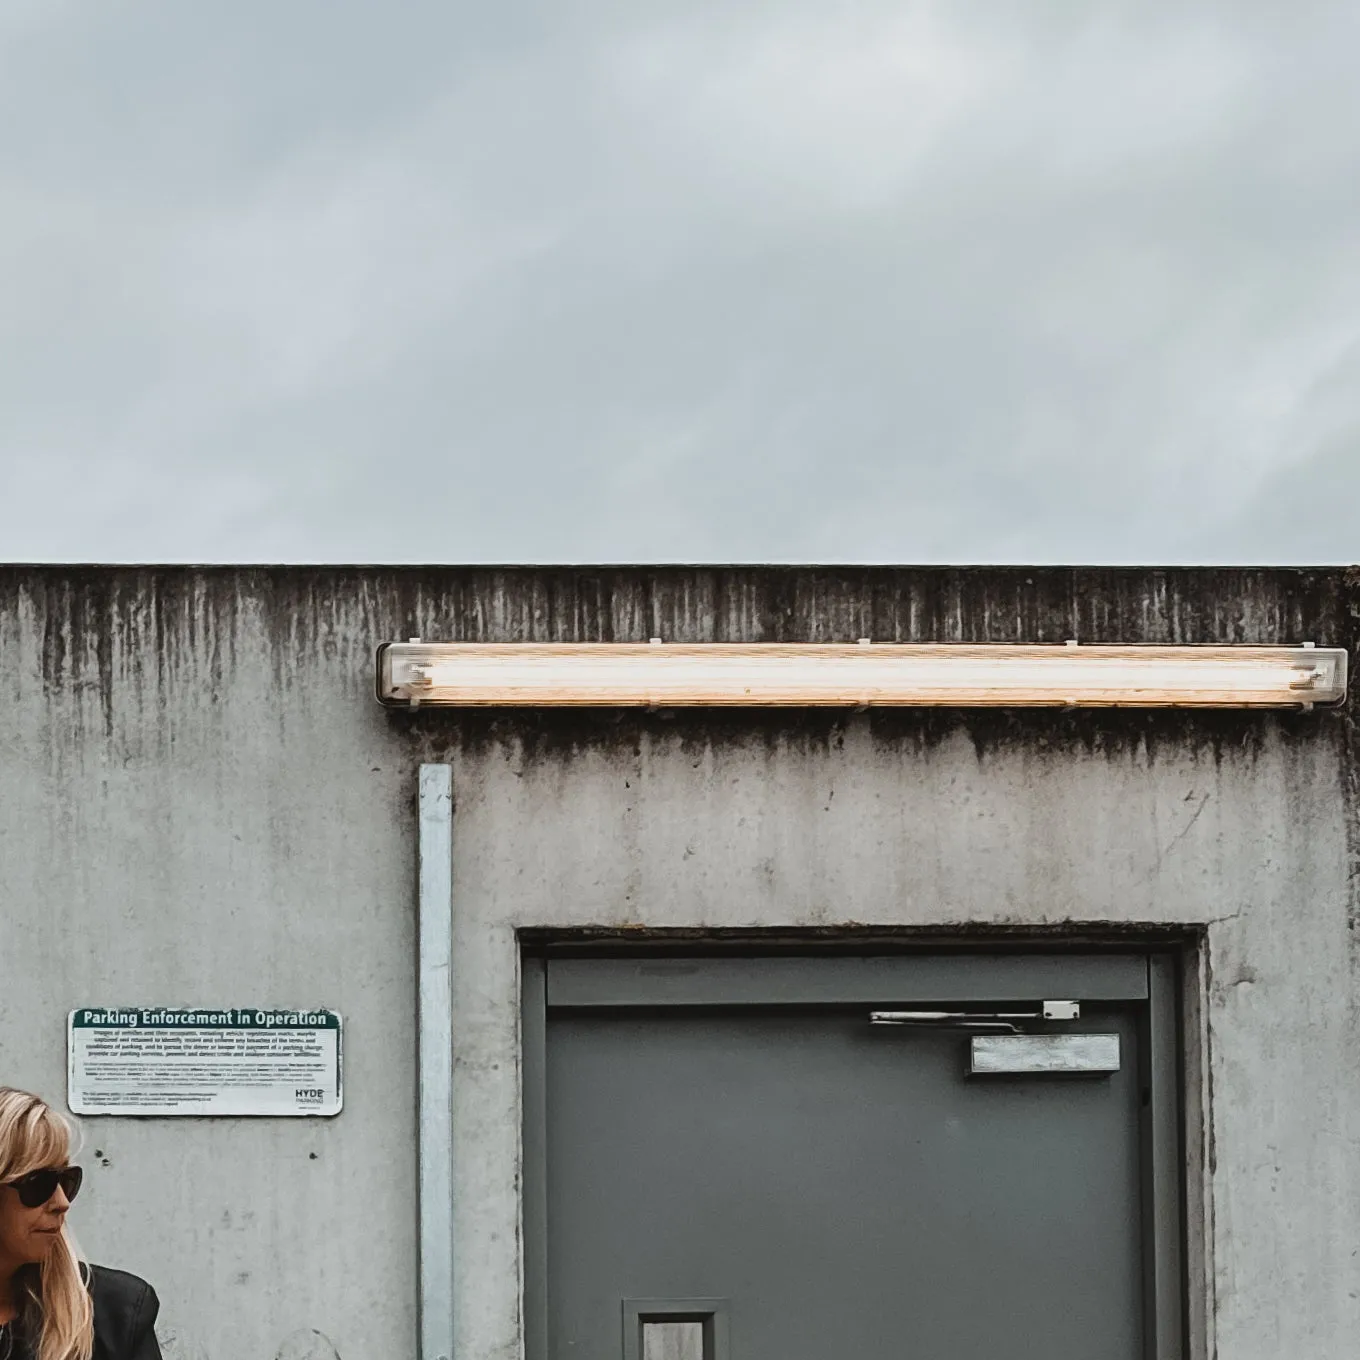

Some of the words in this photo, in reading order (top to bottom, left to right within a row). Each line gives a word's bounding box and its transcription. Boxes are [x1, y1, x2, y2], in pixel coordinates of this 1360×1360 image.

[84, 1011, 137, 1027] Parking
[142, 1011, 233, 1024] Enforcement
[237, 1011, 250, 1024] in
[255, 1011, 327, 1028] Operation
[296, 1089, 324, 1098] HYDE
